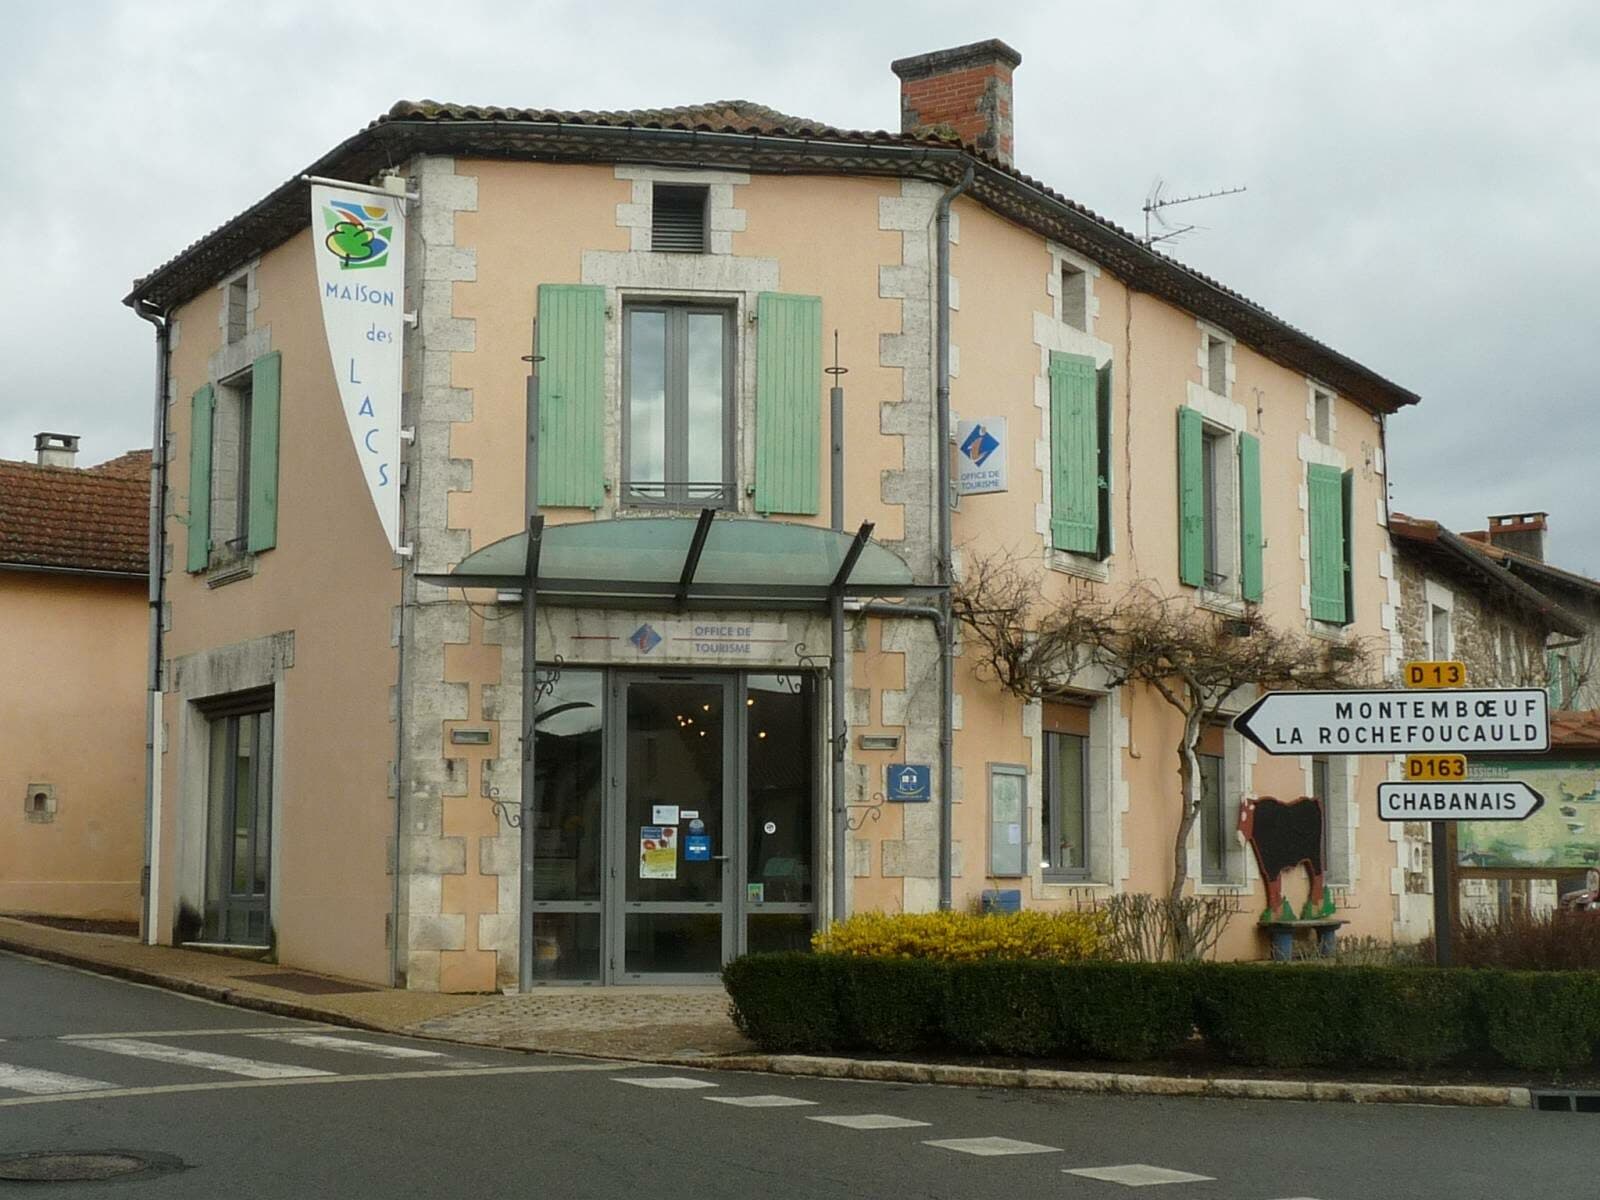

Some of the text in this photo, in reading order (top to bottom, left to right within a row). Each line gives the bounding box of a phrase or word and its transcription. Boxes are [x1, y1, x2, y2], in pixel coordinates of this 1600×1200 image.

[326, 282, 394, 306] MAISON
[366, 322, 393, 344] des
[350, 358, 389, 487] LACS
[695, 626, 752, 637] OFFICE DE
[695, 643, 751, 653] TOURISME
[1411, 666, 1460, 683] D 13
[1335, 700, 1536, 720] MONTEMBŒUF
[1275, 724, 1538, 745] LA ROCHEFOUCAULD
[1410, 759, 1465, 777] D163
[1388, 792, 1517, 811] CHABANAIS
